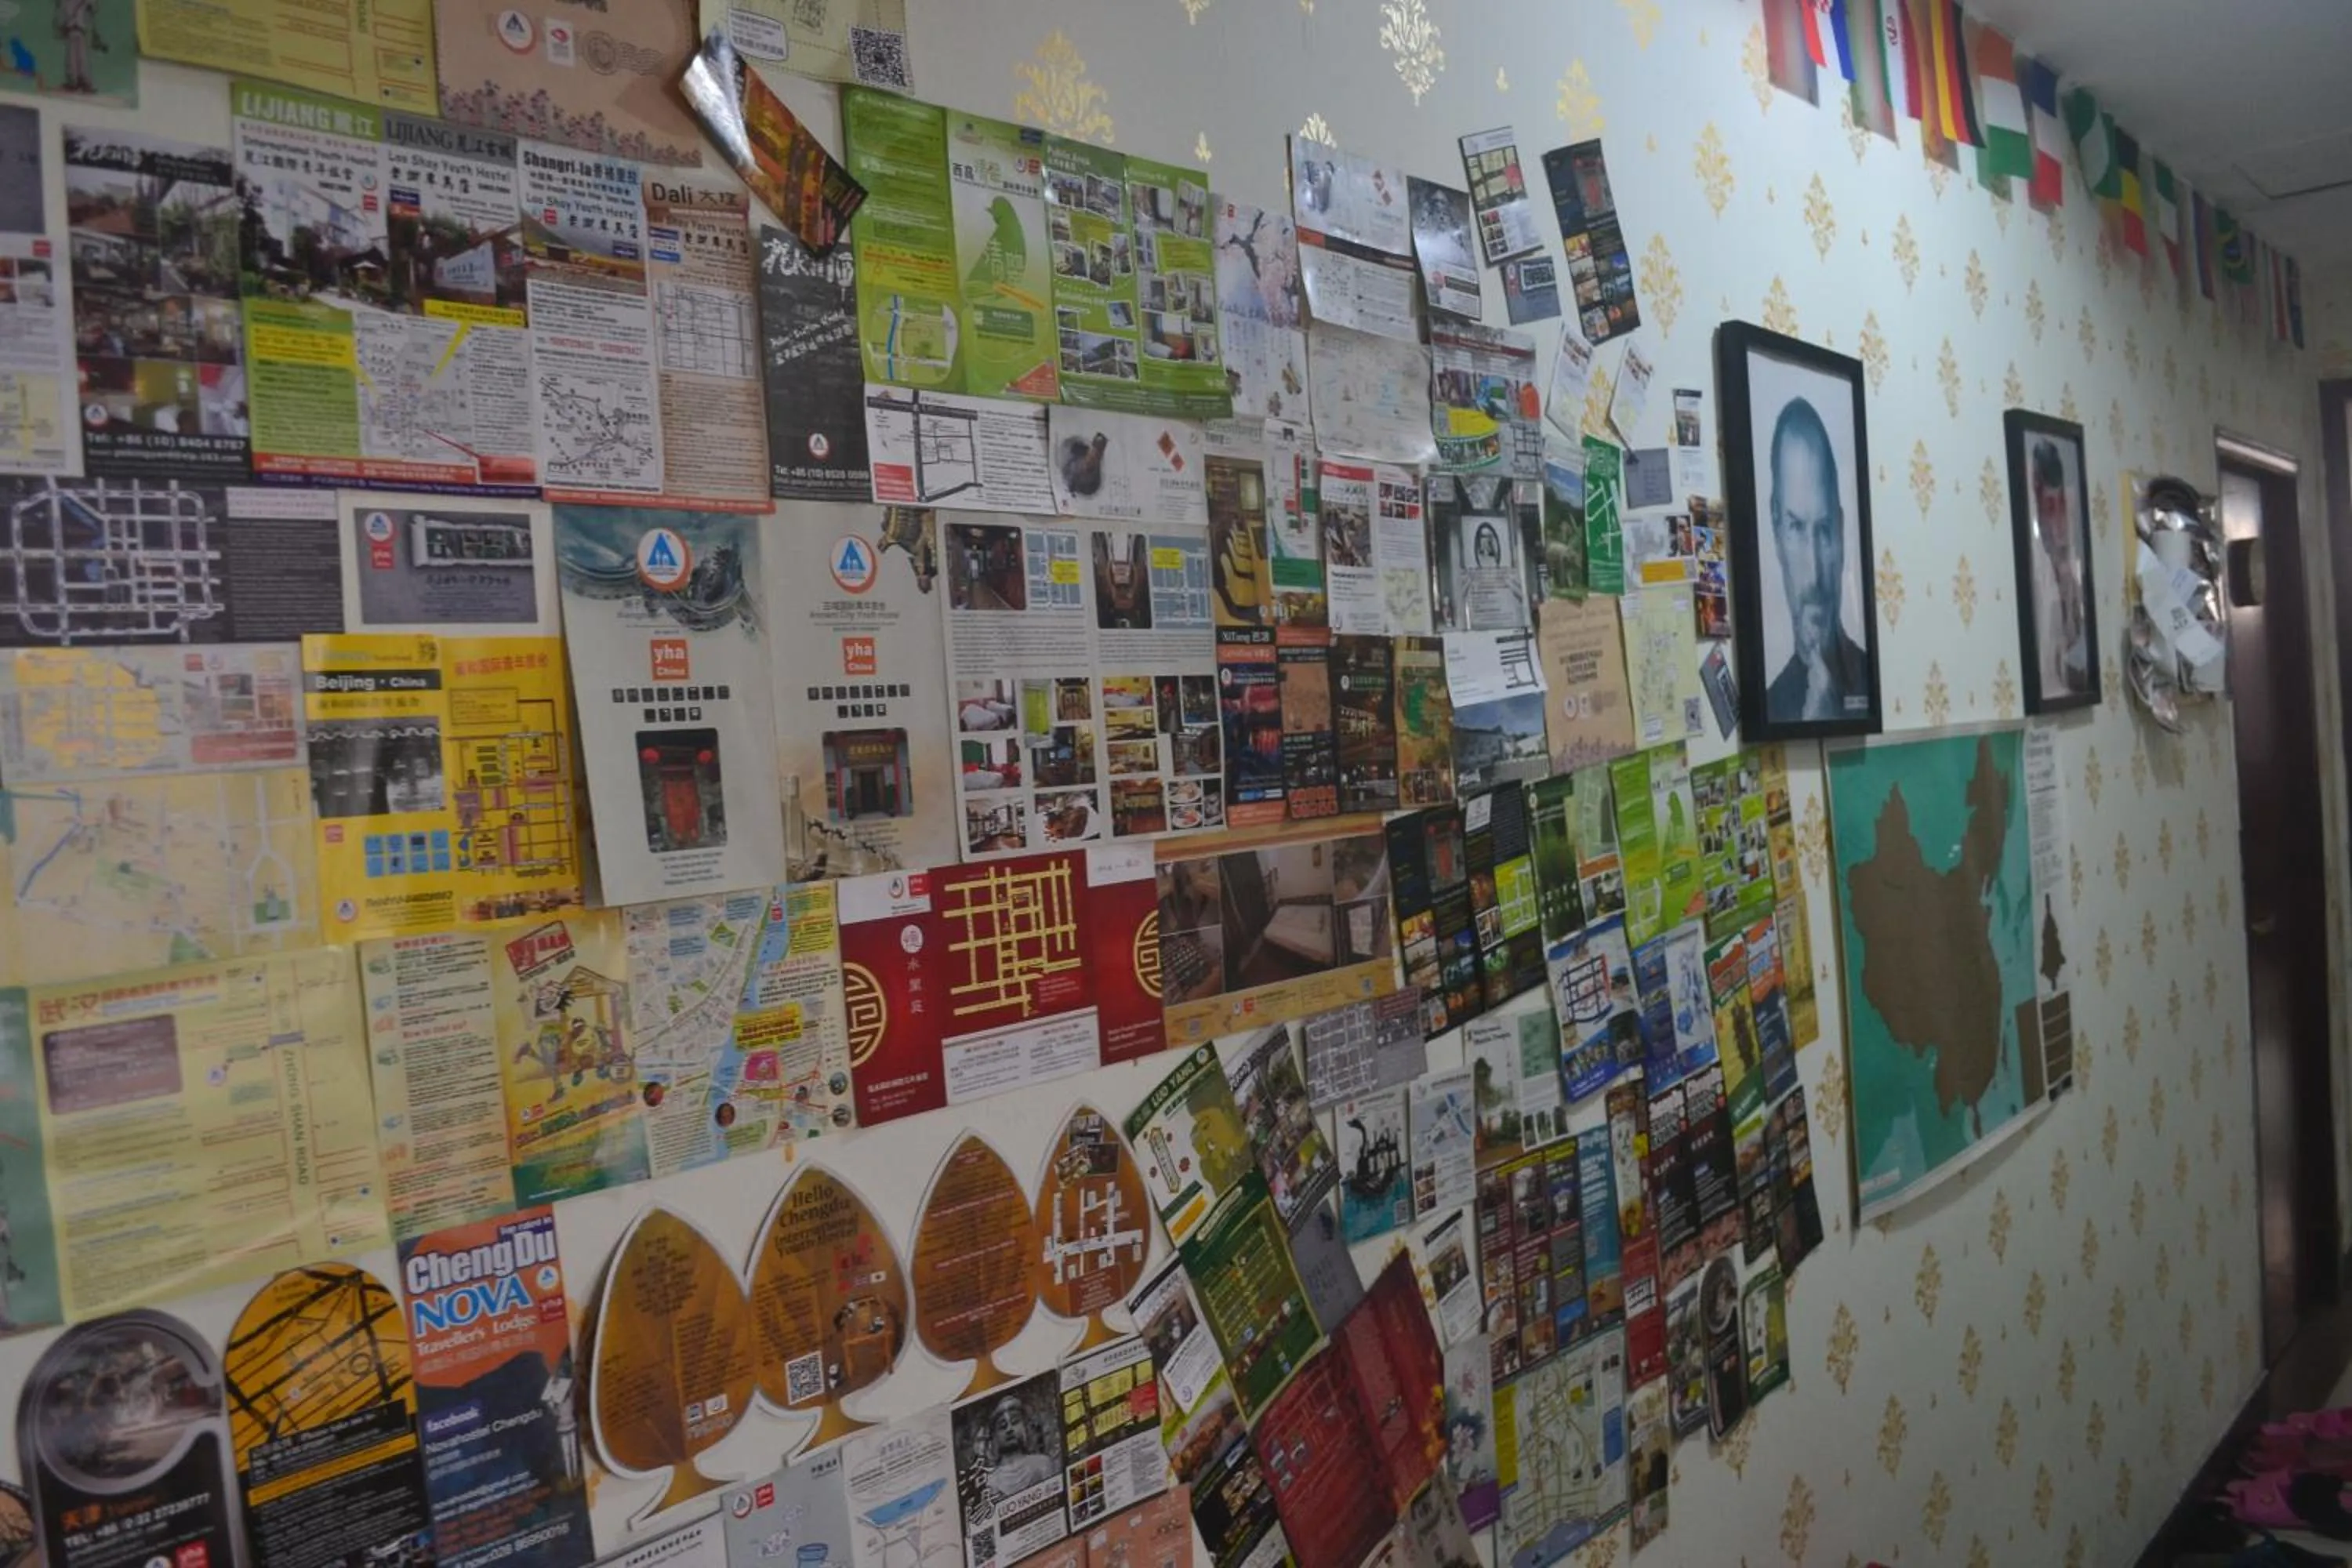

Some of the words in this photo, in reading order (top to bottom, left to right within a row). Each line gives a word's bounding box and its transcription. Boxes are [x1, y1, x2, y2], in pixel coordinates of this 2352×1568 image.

[241, 92, 330, 129] LIJIANG
[386, 119, 452, 150] LIJIANG
[652, 182, 693, 205] Dali
[654, 644, 684, 663] yha
[845, 642, 873, 660] yha
[314, 674, 375, 691] Beijing
[390, 676, 426, 688] China
[793, 1184, 834, 1207] Hello
[779, 1196, 850, 1228] Chengdu
[407, 1230, 556, 1294] ChengDu
[412, 1273, 533, 1338] NOVA
[492, 1314, 537, 1333] Lodge
[426, 1406, 481, 1433] facebook
[492, 1408, 543, 1432] Chengdu
